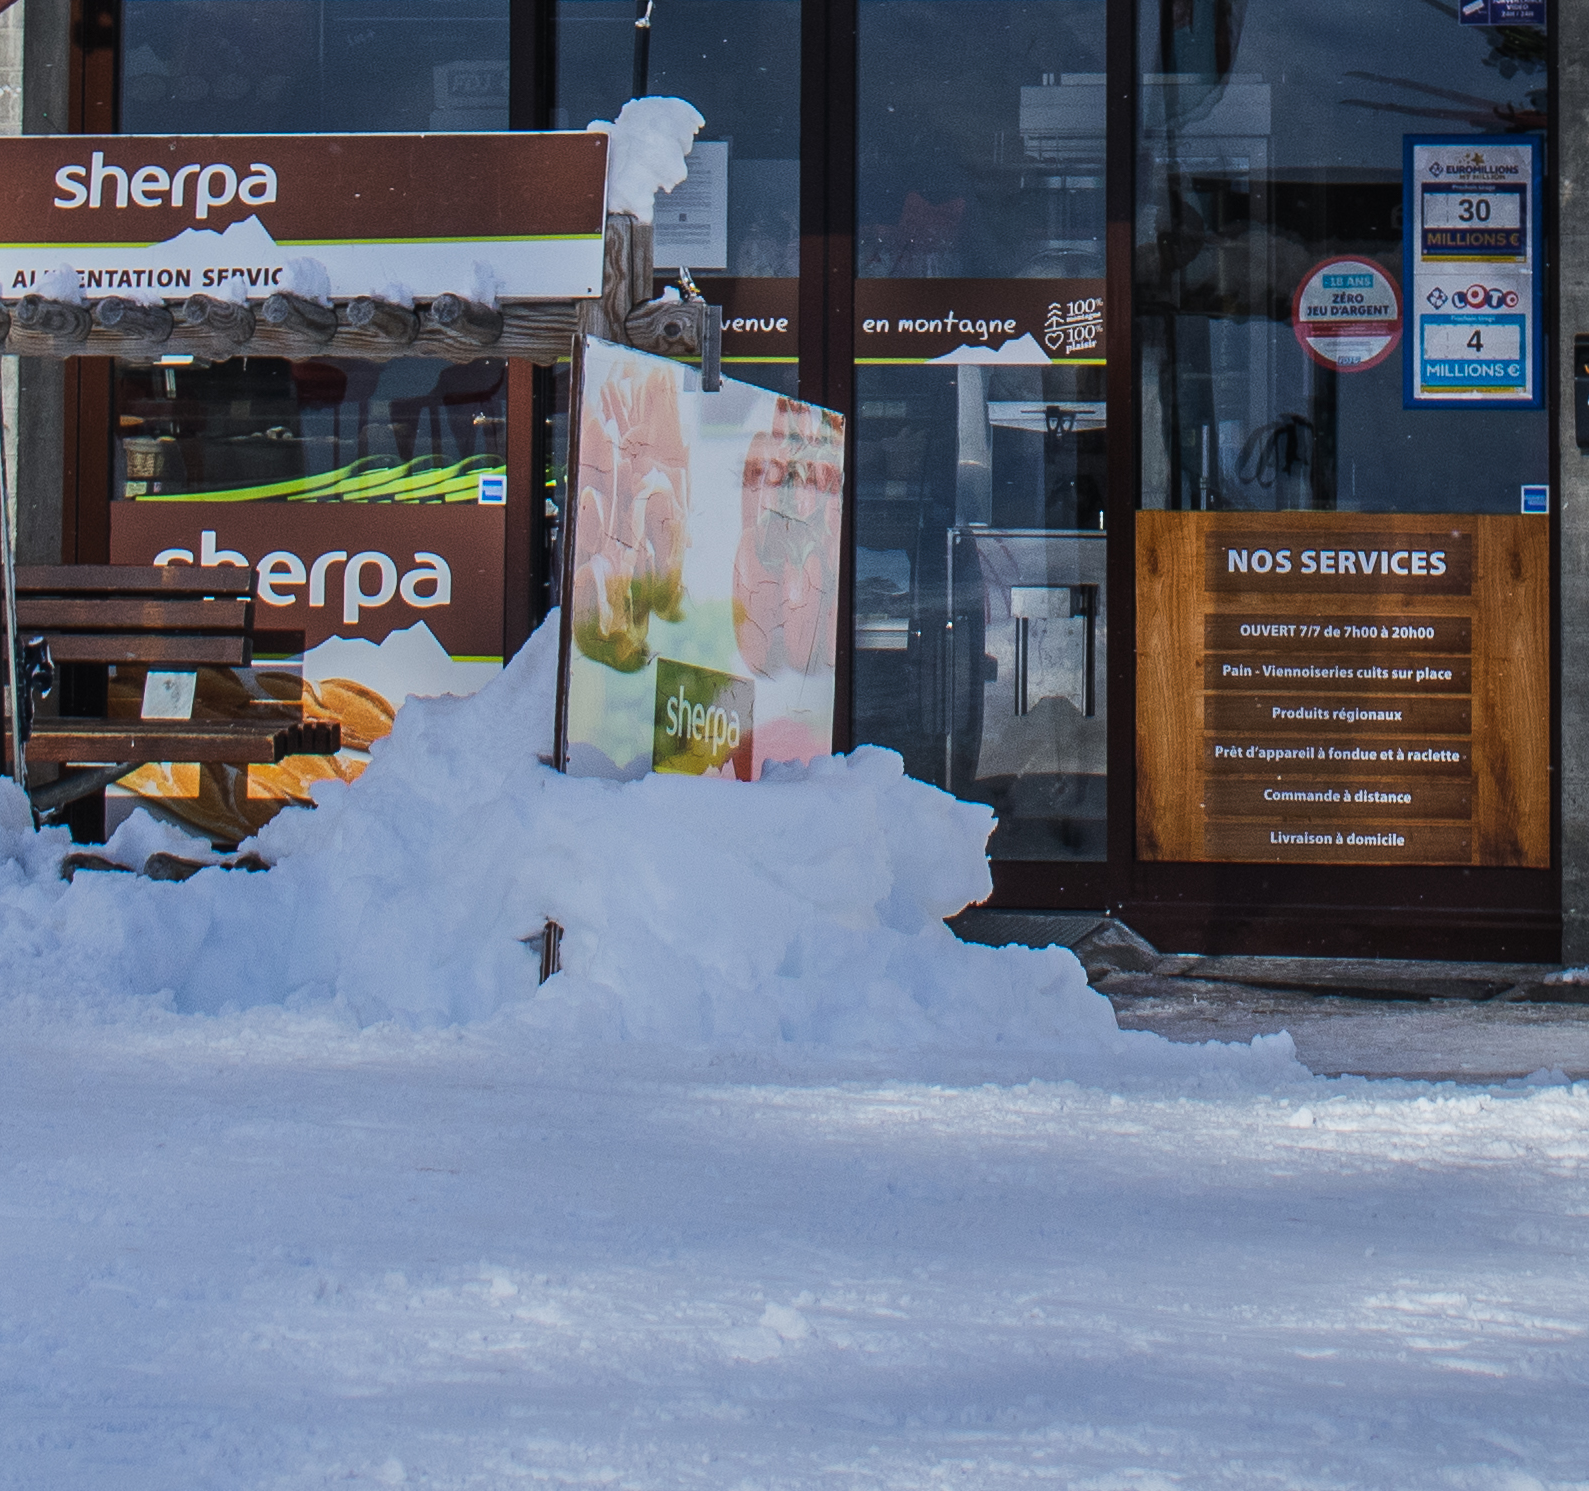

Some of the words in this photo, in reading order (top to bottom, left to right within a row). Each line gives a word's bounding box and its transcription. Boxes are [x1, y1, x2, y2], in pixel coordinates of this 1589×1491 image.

[1446, 165, 1519, 174] EUROMILLIONS
[54, 152, 277, 218] sherpa
[1458, 198, 1491, 222] 30
[1427, 233, 1506, 246] MILLIONS
[1509, 233, 1520, 246] €
[12, 269, 190, 288] ALNTATION
[1347, 278, 1371, 287] ANS
[1332, 292, 1364, 304] ZÉRO
[1452, 284, 1519, 309] LOTO
[1307, 306, 1327, 316] JEU
[1331, 305, 1389, 316] D'ARGENT
[721, 317, 788, 332] venue
[863, 319, 889, 333] en
[898, 310, 1017, 340] montagne
[1467, 329, 1484, 352] 4
[1427, 364, 1504, 377] MILLIONS
[1508, 364, 1520, 377] €
[1228, 549, 1292, 573] NOS
[1300, 550, 1447, 576] SERVICES
[1240, 624, 1296, 637] OUVERT
[1299, 624, 1320, 638] 7/7
[1323, 624, 1341, 638] de
[1344, 625, 1378, 638] 7h00
[1380, 625, 1389, 638] à
[1391, 626, 1435, 639] 20h00
[1222, 664, 1252, 677] Pain
[1262, 664, 1354, 679] Viennoiseries
[1356, 665, 1389, 680] cuits
[1391, 668, 1413, 680] sur
[1416, 667, 1453, 683] place
[666, 685, 740, 757] sherpa
[1272, 706, 1330, 720] Produits
[1332, 707, 1403, 723] régionaux
[1215, 745, 1243, 759] Prêt
[1246, 746, 1315, 761] d'appareil
[1317, 747, 1325, 759] à
[1328, 747, 1377, 760] fondue
[1379, 749, 1394, 760] et
[1396, 748, 1404, 761] à
[1407, 749, 1460, 762] raclette
[1264, 788, 1340, 802] Commande
[1343, 789, 1351, 802] à
[1354, 790, 1412, 804] distance
[1270, 831, 1333, 845] Livraison
[1336, 832, 1343, 845] à
[1346, 833, 1405, 846] domicile
